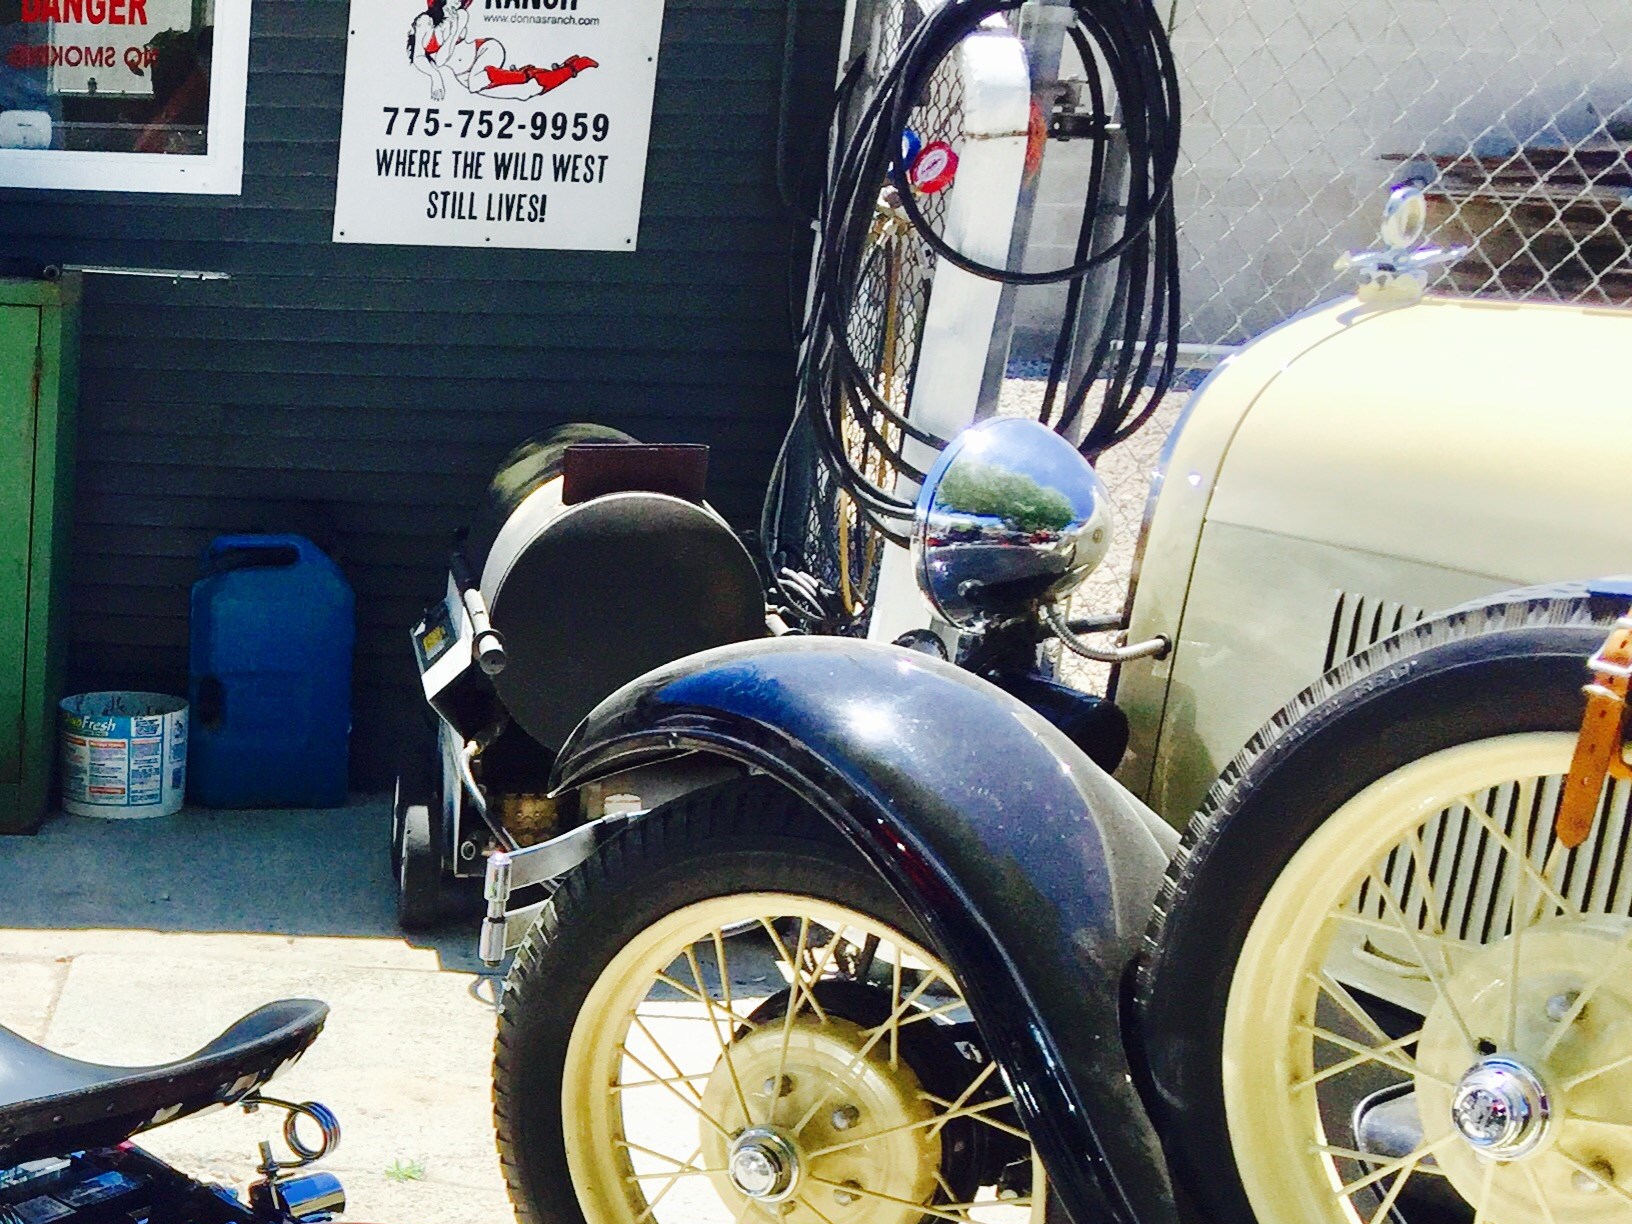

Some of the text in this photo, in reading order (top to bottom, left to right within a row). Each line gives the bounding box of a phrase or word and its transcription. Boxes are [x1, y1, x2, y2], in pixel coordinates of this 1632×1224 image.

[21, 0, 148, 25] DANGER
[483, 13, 600, 26] www.donnasranch.com
[382, 106, 610, 142] 775-752-9959
[375, 148, 609, 184] WHERE THE WILD WEST
[426, 190, 548, 223] STILL LIVES!
